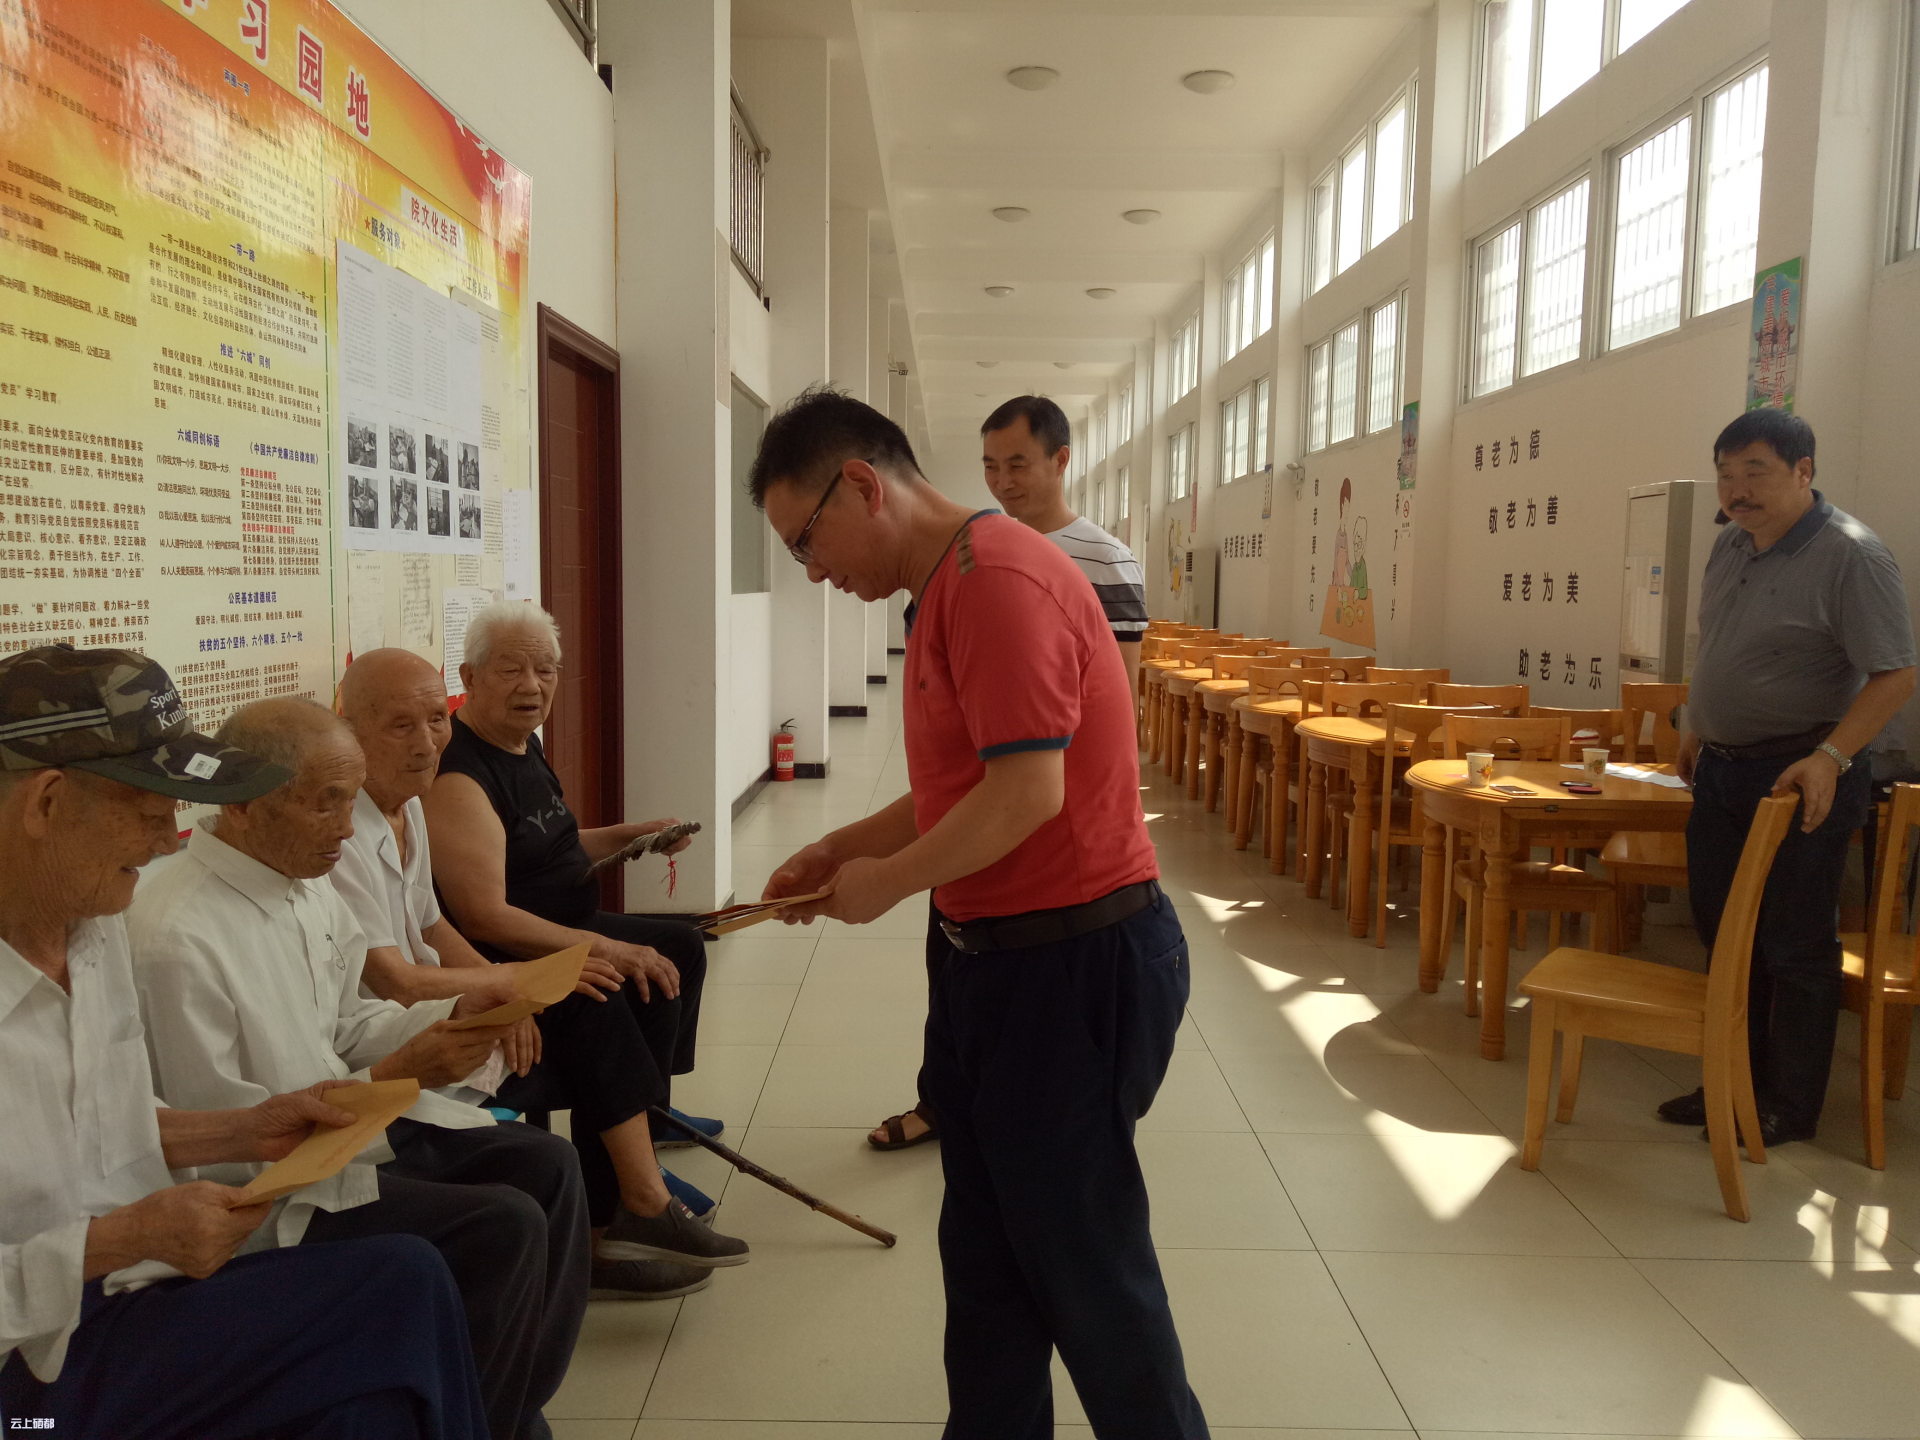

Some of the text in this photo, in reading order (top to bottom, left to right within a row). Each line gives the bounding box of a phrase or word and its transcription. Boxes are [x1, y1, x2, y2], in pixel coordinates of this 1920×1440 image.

[411, 197, 458, 248] 院文化生活
[229, 238, 255, 263] 一带一路
[177, 427, 219, 448] 六城同创标语
[1474, 429, 1541, 471] 尊老为德
[1488, 495, 1558, 534] 敬老为善
[228, 591, 276, 605] 公民基本道德规范
[1502, 571, 1579, 603] 爱老为美
[1518, 648, 1602, 690] 助老为乐
[150, 688, 177, 709] Sport
[526, 794, 567, 834] Y-3
